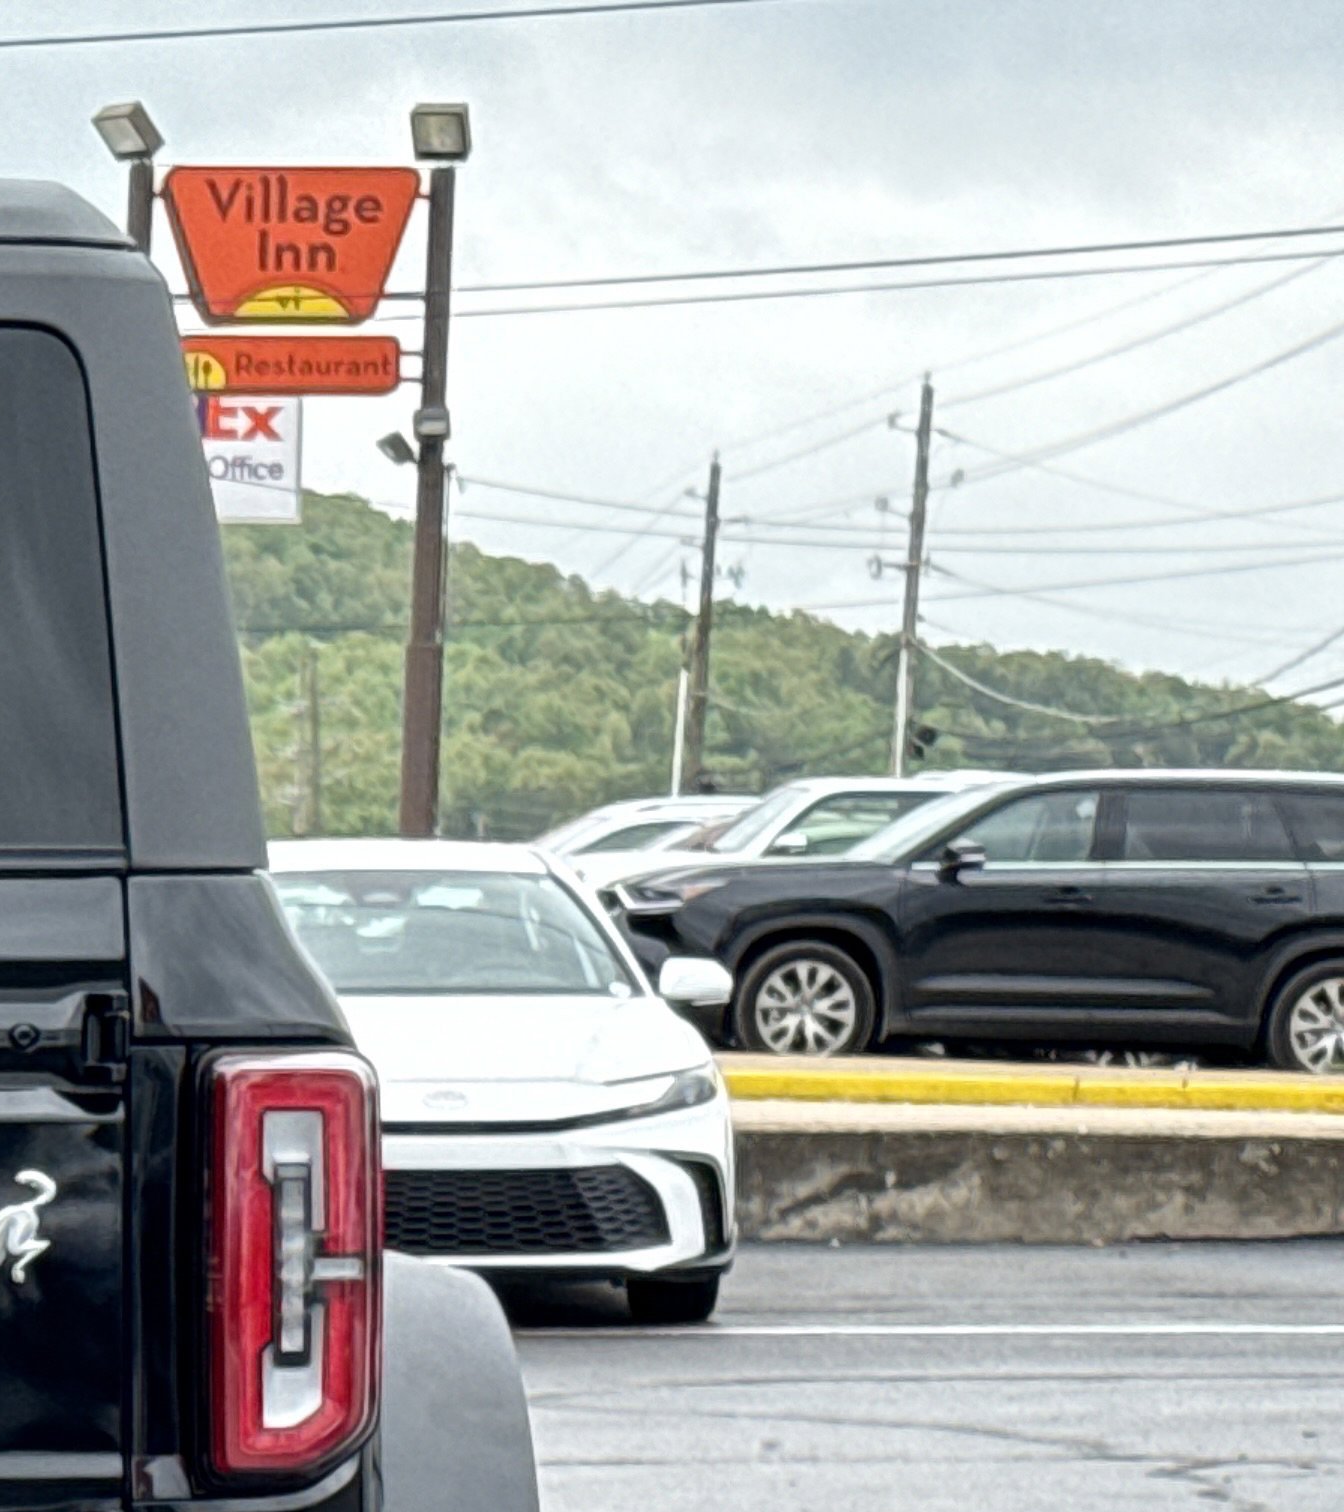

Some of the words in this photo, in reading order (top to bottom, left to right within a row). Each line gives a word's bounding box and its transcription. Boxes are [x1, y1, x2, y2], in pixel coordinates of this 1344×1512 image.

[205, 174, 384, 236] Village
[258, 228, 336, 272] Inn
[234, 352, 392, 377] Restaurant
[209, 455, 284, 481] Office
